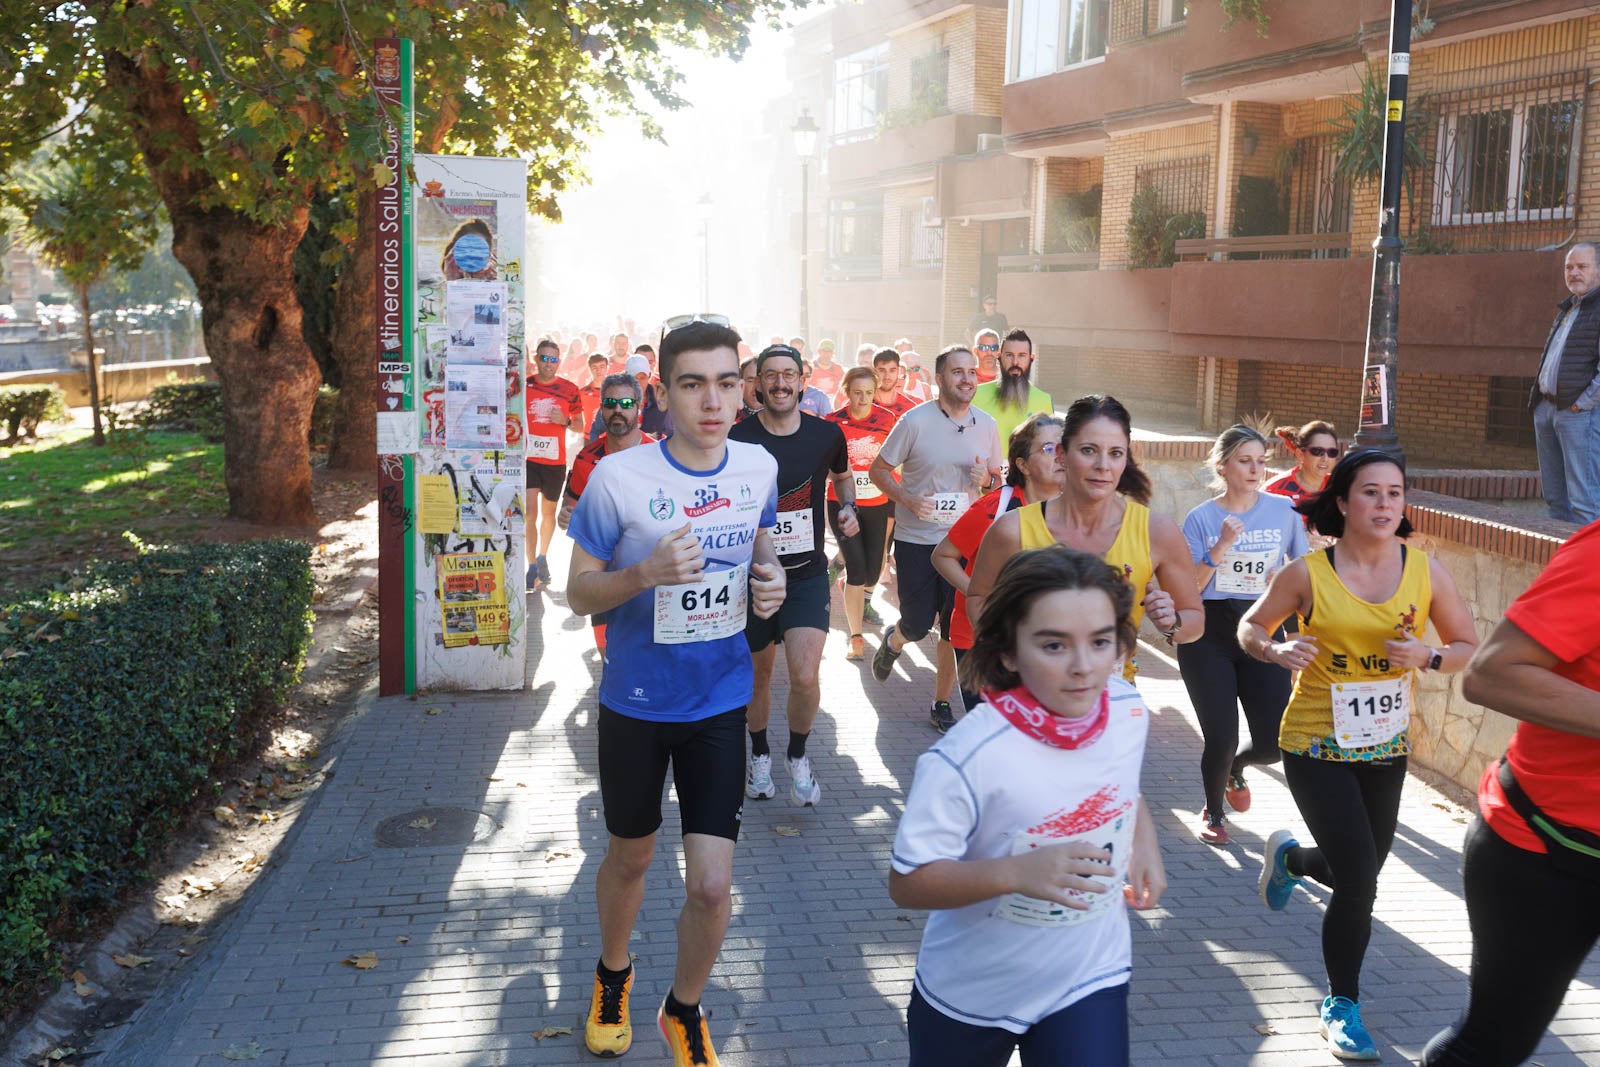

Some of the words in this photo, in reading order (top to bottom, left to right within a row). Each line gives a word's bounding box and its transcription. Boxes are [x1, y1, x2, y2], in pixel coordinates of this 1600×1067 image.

[380, 364, 410, 372] MPS
[534, 441, 551, 449] 607
[856, 477, 872, 486] 63
[694, 484, 719, 508] 35
[706, 522, 747, 532] ATLETISMO
[773, 521, 792, 535] 35
[1233, 560, 1264, 574] 618
[681, 584, 730, 611] 614
[477, 612, 495, 624] 149
[499, 612, 507, 622] €
[687, 612, 720, 622] MORLAKO
[1348, 691, 1402, 717] 1195
